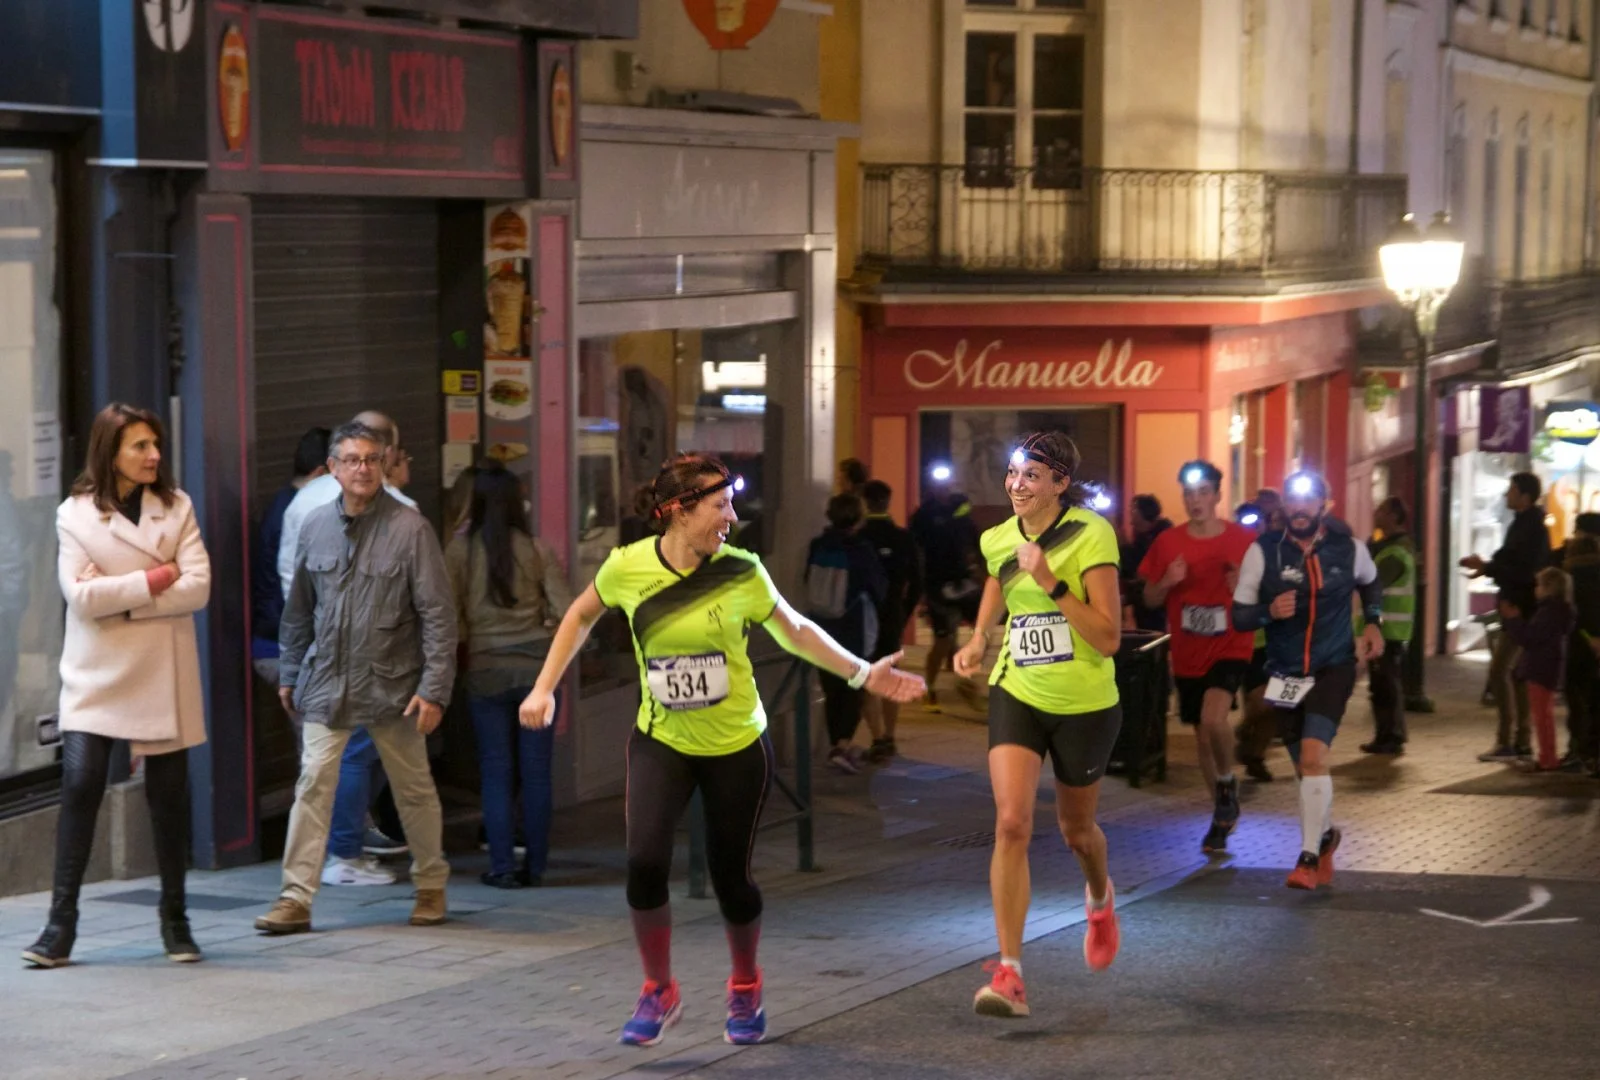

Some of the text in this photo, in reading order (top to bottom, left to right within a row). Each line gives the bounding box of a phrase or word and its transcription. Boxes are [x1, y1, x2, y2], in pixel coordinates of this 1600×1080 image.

[389, 51, 466, 133] KEBAB
[903, 338, 1164, 390] Manuella
[1019, 628, 1055, 656] 490
[666, 671, 709, 700] 534
